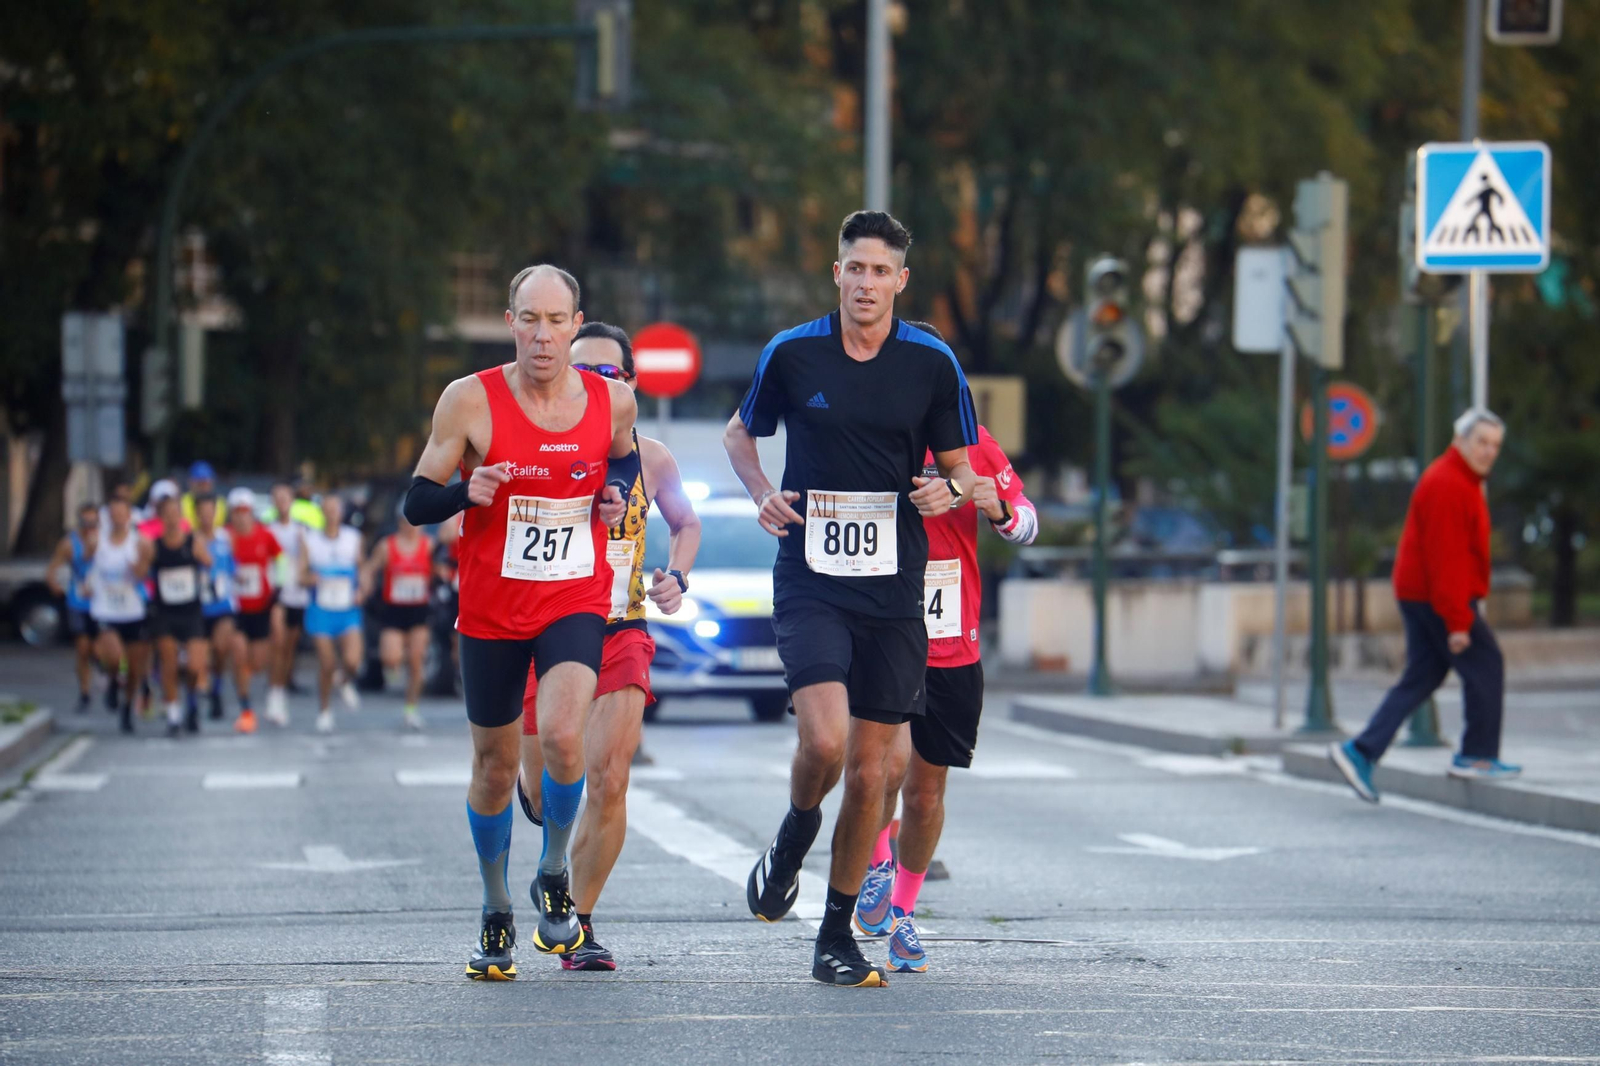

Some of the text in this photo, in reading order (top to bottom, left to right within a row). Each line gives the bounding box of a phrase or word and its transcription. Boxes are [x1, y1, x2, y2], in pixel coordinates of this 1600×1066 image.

[513, 465, 549, 476] califas
[512, 499, 539, 523] XLI
[811, 494, 836, 518] XLI
[522, 526, 574, 561] 257
[823, 521, 878, 557] 809
[928, 588, 943, 620] 4
